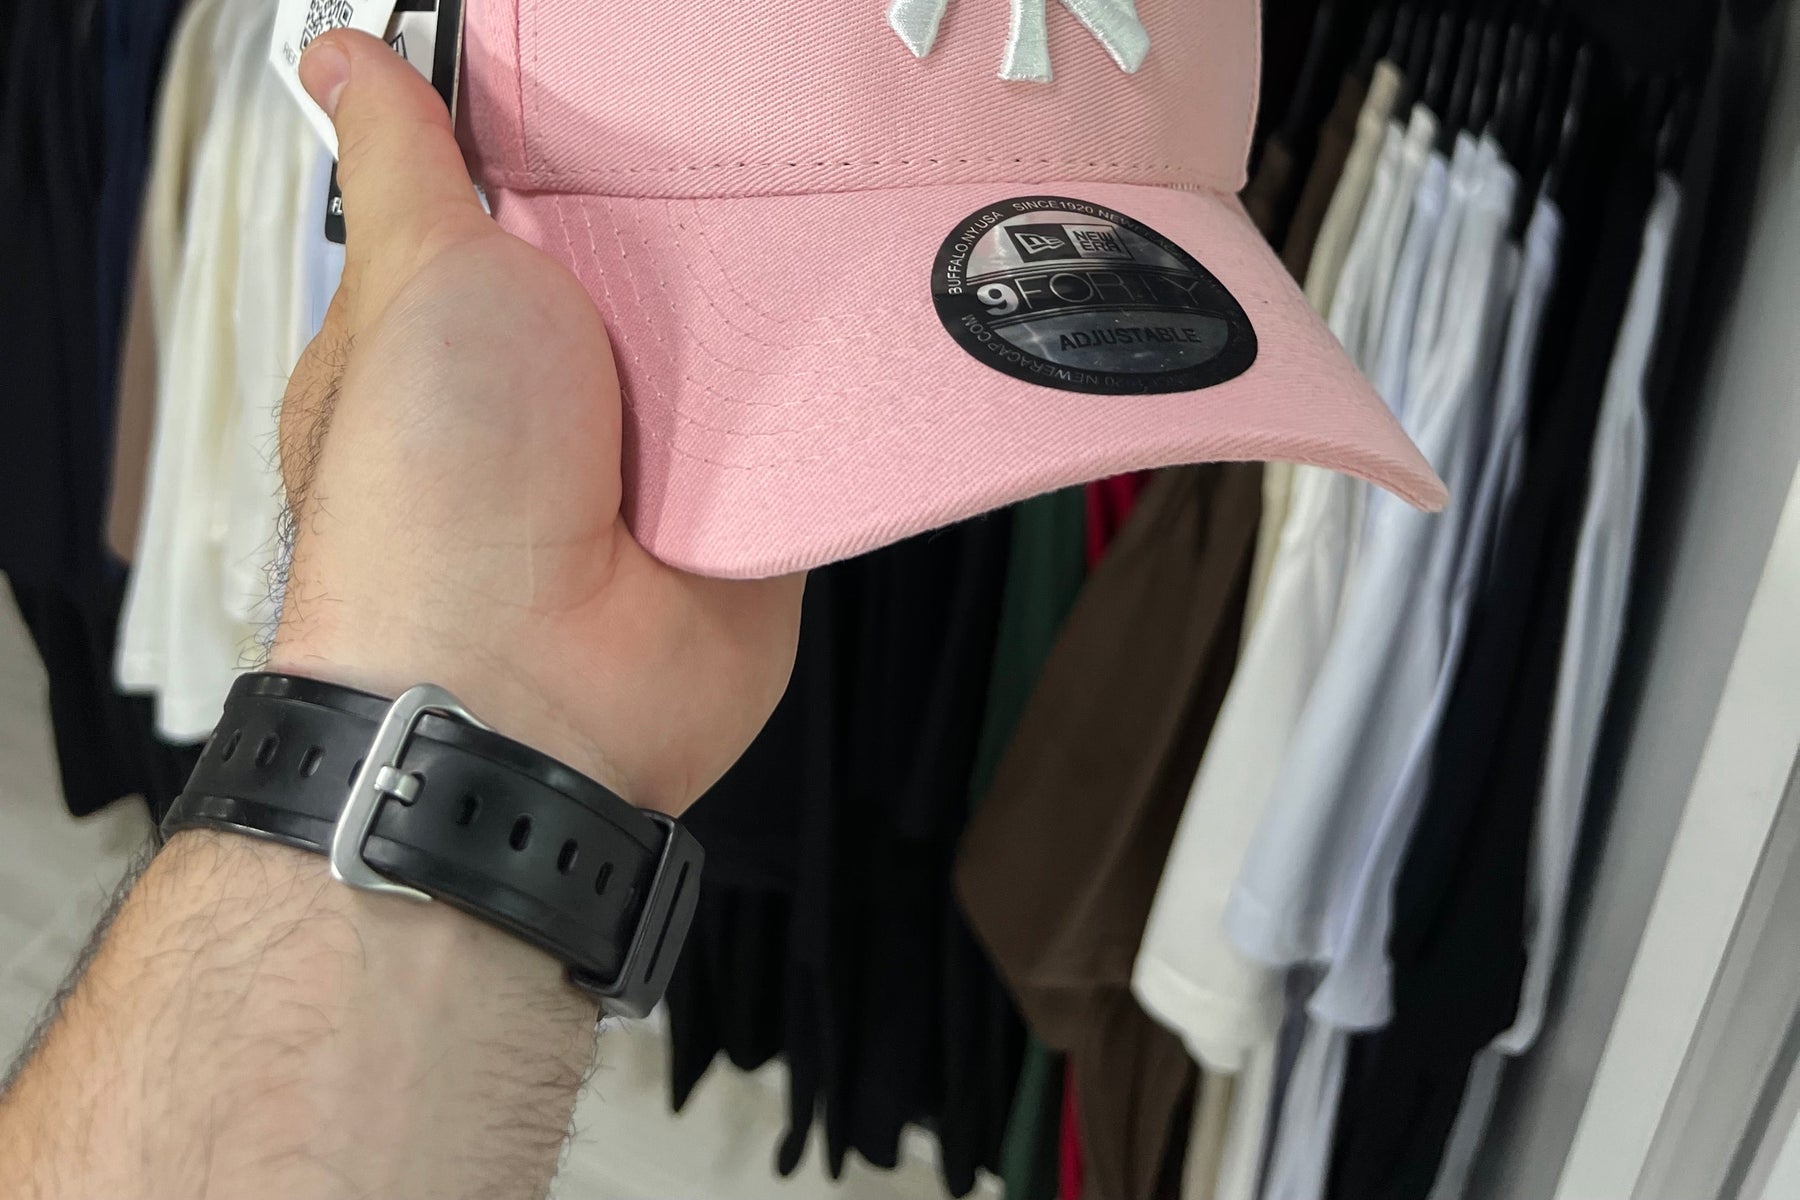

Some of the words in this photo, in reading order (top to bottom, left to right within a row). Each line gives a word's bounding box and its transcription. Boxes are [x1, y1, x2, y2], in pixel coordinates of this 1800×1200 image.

[1072, 230, 1114, 242] NEW
[1081, 241, 1121, 252] ERA
[976, 272, 1200, 316] 9FORTY
[1059, 327, 1201, 351] ADJUSTABLE
